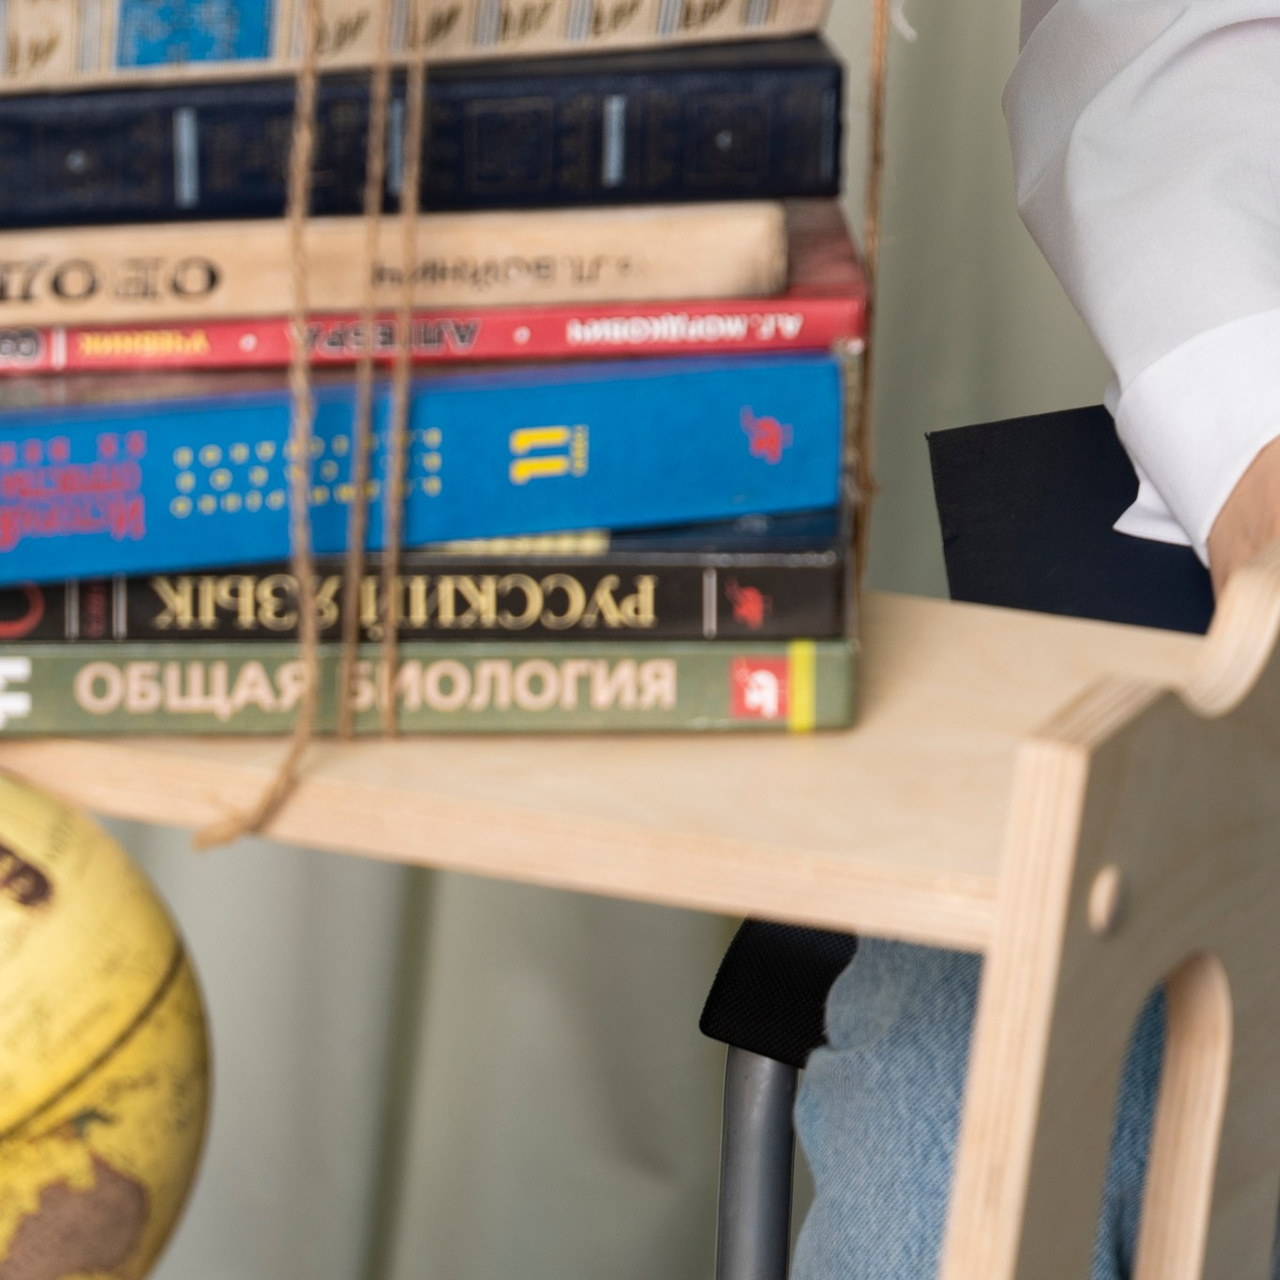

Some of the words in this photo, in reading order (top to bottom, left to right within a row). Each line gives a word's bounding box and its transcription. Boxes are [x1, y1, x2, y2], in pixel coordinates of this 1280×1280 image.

[78, 328, 208, 356] УЧЕБНИК
[510, 426, 570, 484] 11
[148, 574, 343, 630] ЯЗЫК
[357, 574, 658, 639] РУССКИЙ
[73, 660, 312, 718] ОБЩАЯ
[346, 658, 676, 711] БИОЛОГИЯ
